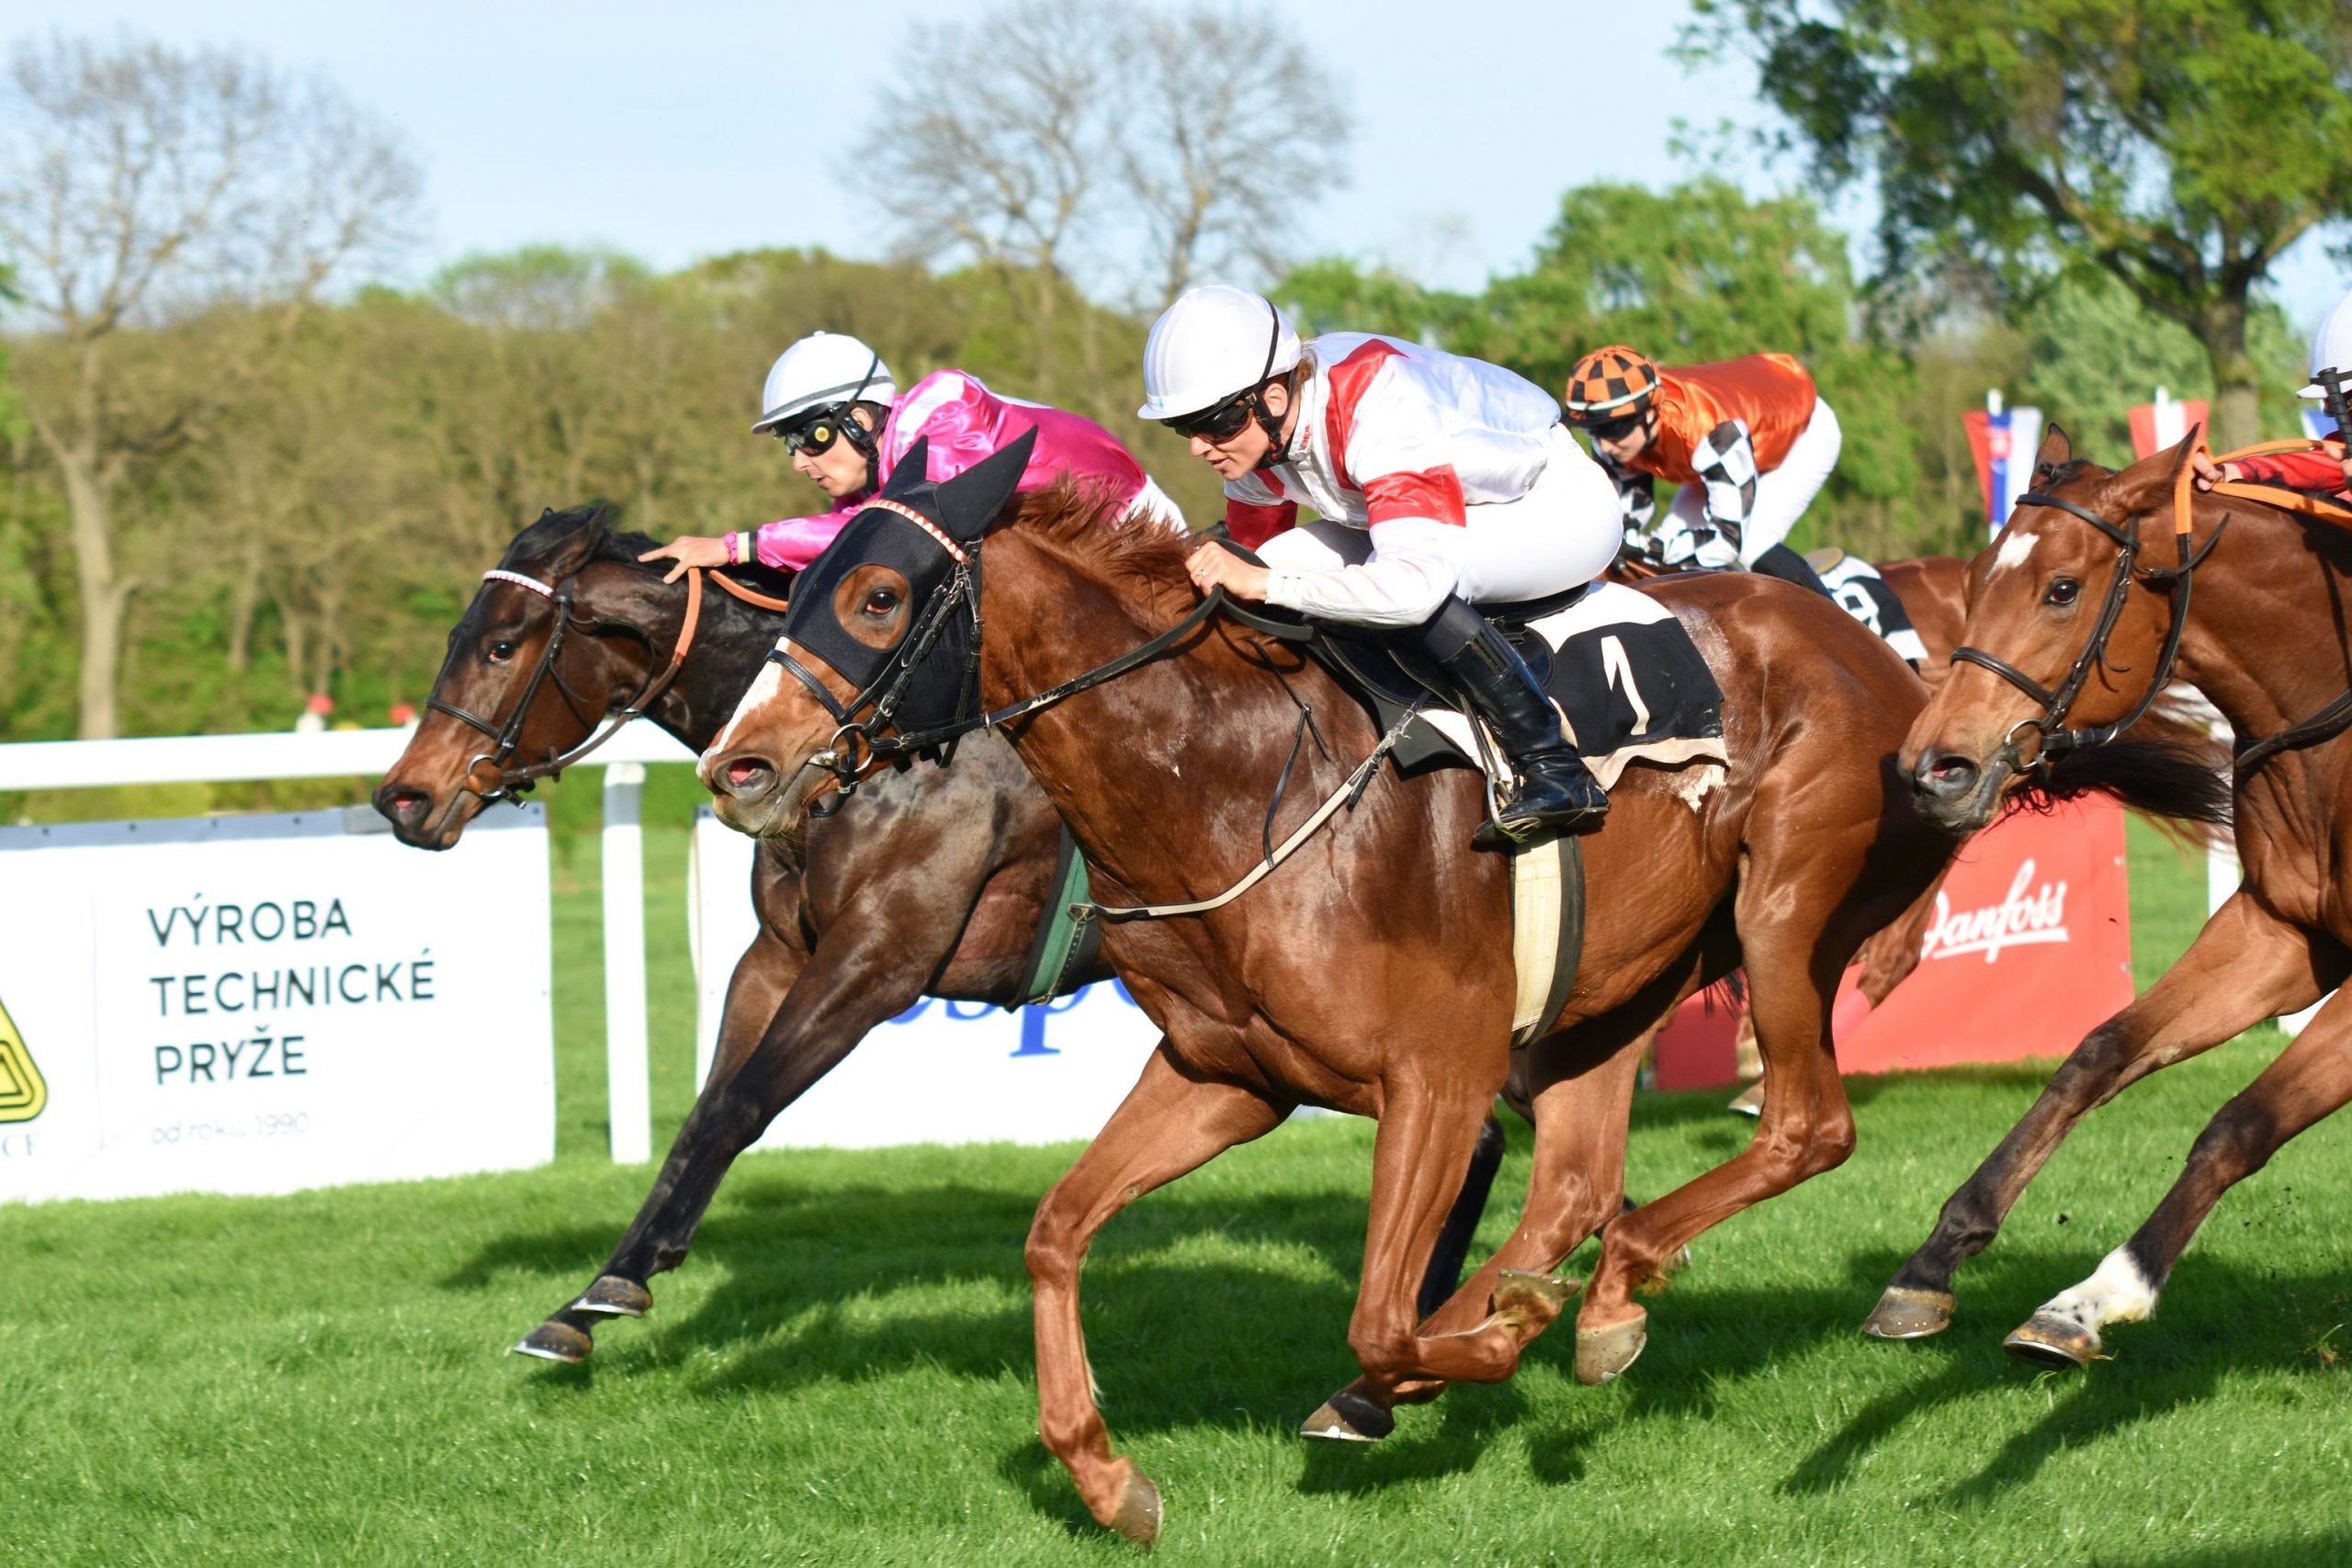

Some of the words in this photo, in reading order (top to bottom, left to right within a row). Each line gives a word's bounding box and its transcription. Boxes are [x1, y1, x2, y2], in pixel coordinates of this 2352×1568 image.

[1600, 635, 1650, 736] 1
[147, 892, 353, 948] VÝROBA
[149, 948, 435, 1017] TECHNICKÉ
[155, 1023, 308, 1086] PRYŽE
[150, 1120, 182, 1145] od
[187, 1116, 247, 1141] roku
[254, 1111, 311, 1137] 1990
